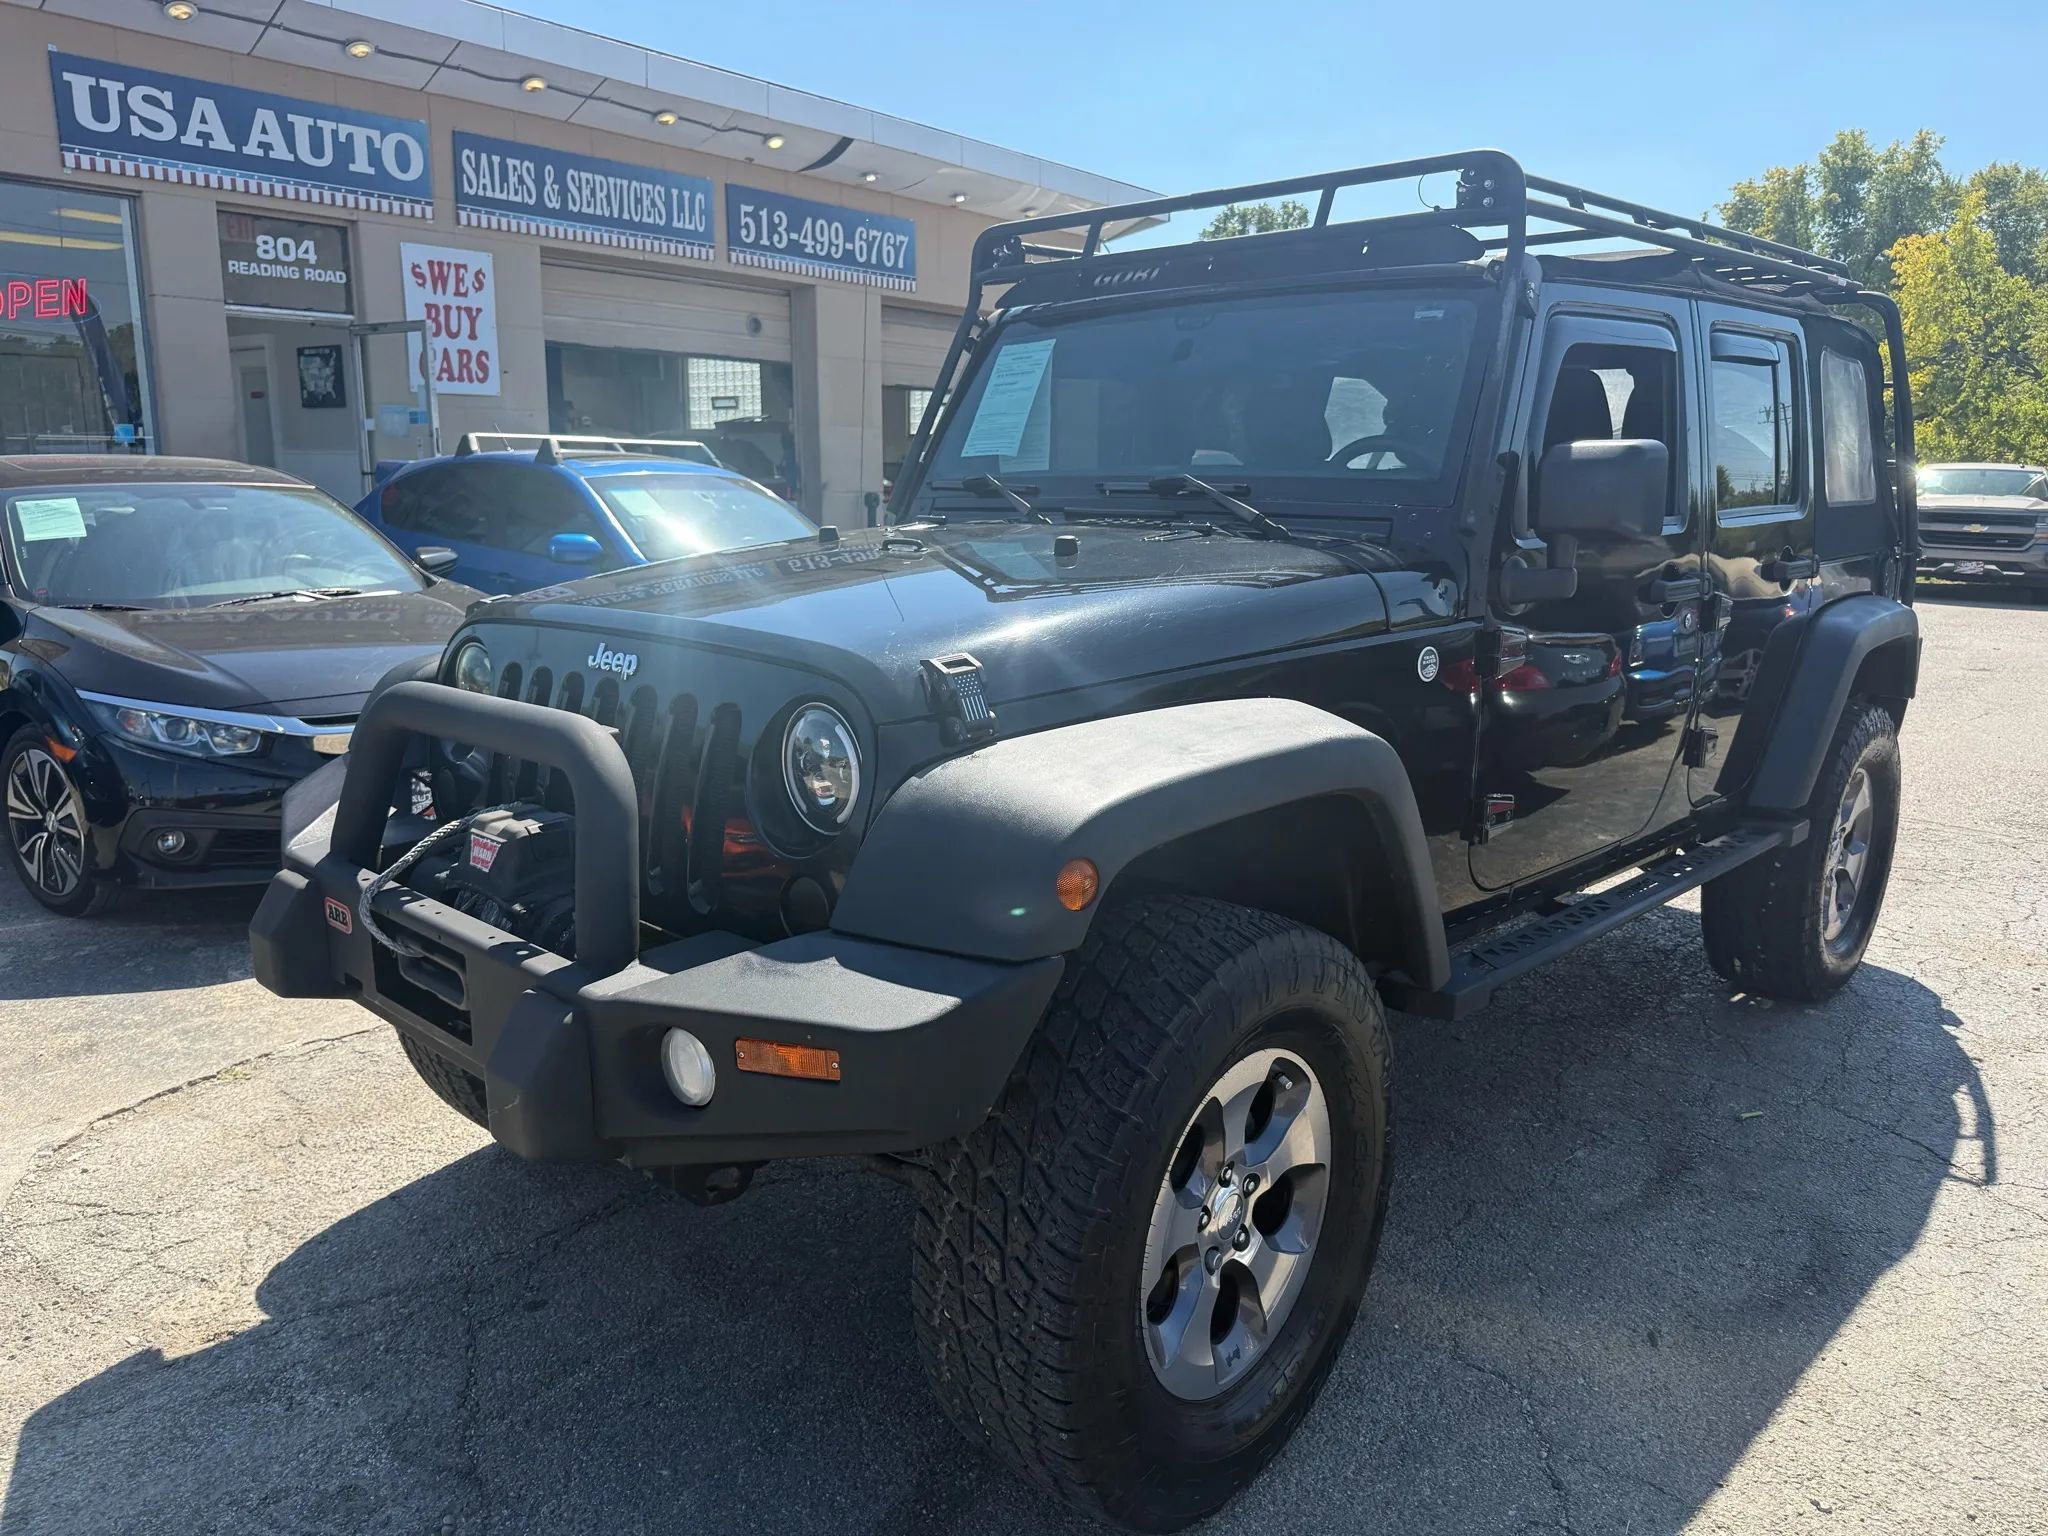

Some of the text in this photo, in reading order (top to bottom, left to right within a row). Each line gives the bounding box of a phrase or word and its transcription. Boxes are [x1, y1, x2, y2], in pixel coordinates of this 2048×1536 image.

[62, 71, 425, 181] USA AUTO
[462, 148, 706, 233] SALES & SERVICES LLC
[255, 234, 317, 264] 804
[740, 203, 909, 269] 513-499-6767
[227, 259, 347, 284] READING ROAD
[0, 277, 87, 320] PEN
[424, 303, 483, 341] BUY
[588, 642, 638, 680] Jeep
[327, 903, 349, 927] ARB
